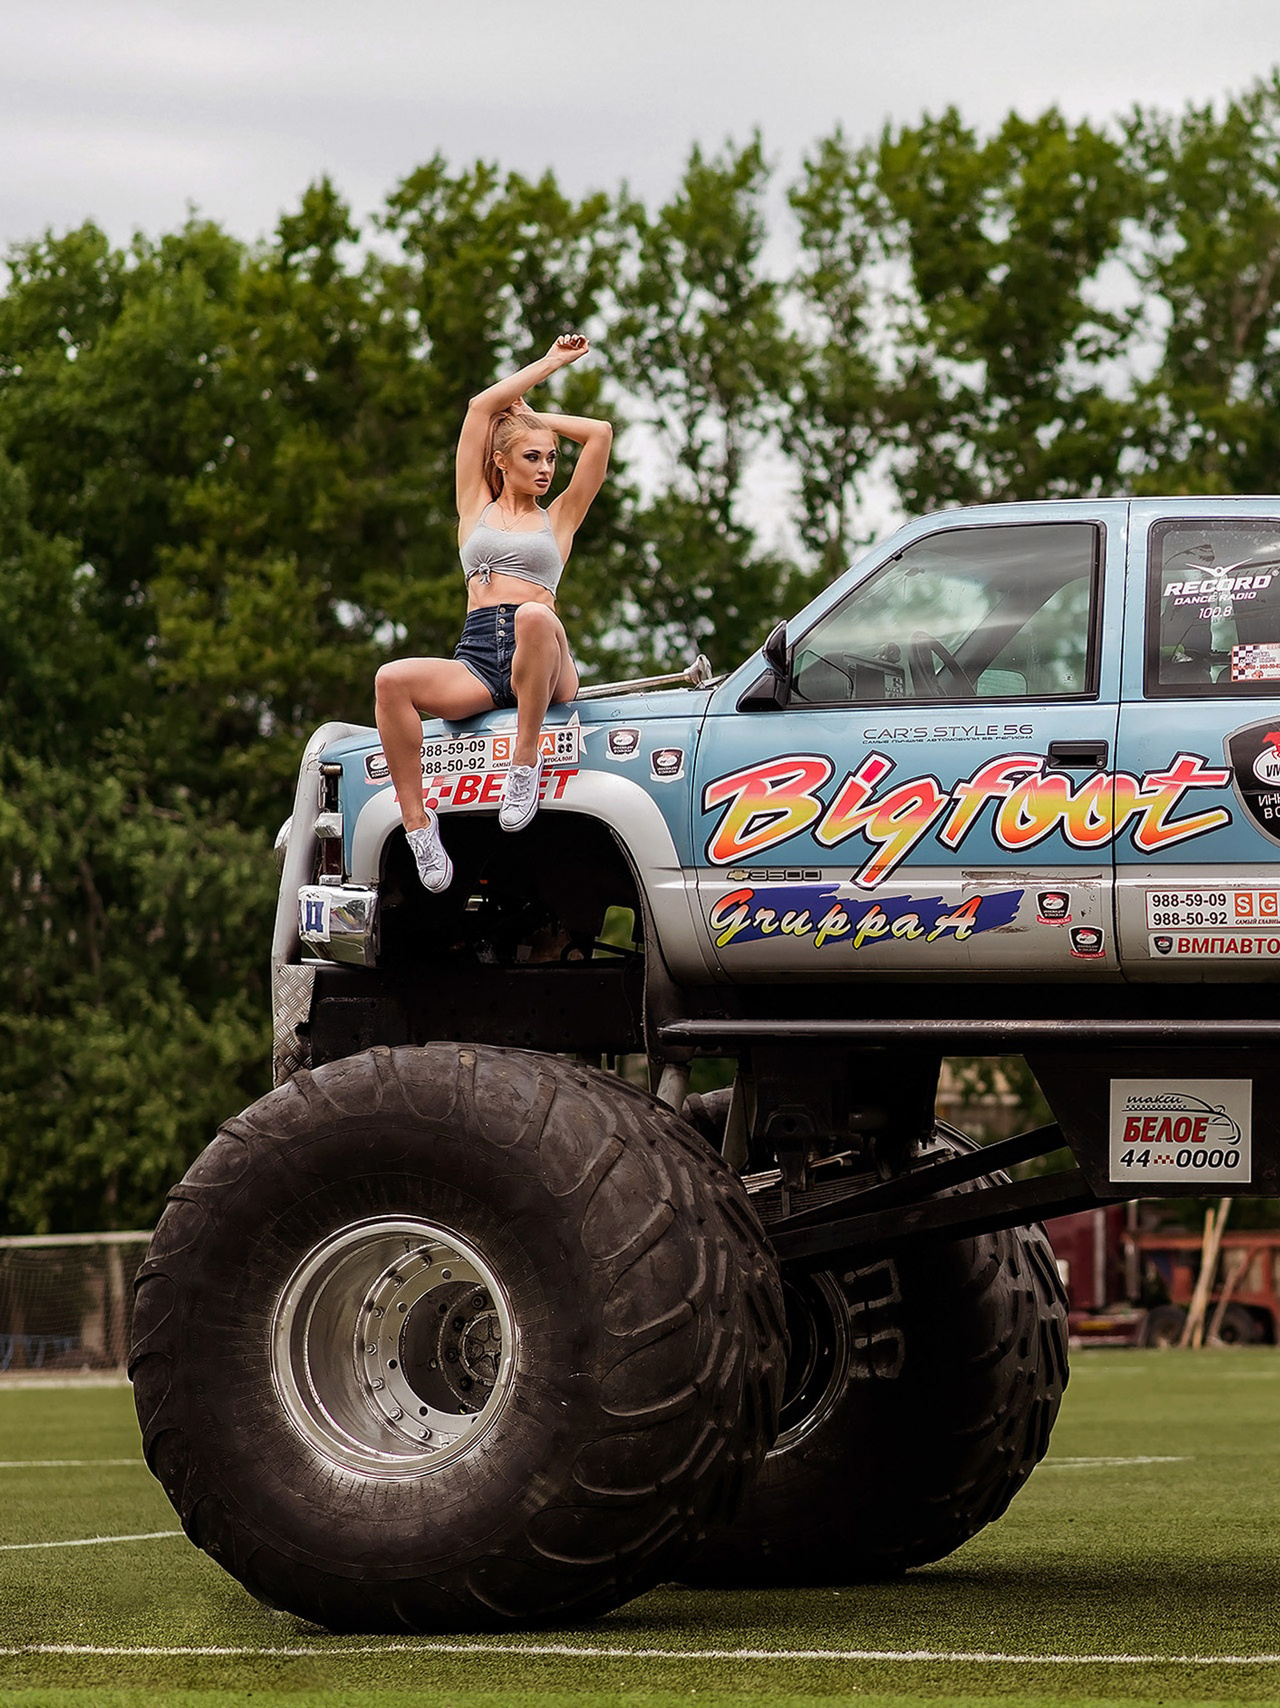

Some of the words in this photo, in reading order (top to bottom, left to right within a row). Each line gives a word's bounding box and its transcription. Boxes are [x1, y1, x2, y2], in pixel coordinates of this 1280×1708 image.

[1164, 575, 1272, 597] RECORD
[1174, 594, 1218, 605] DANCE
[1219, 592, 1257, 602] RADIO
[1199, 606, 1232, 619] 100.8
[863, 726, 928, 740] CAR'S
[933, 725, 998, 738] STYLE
[1003, 724, 1033, 736] 56
[494, 736, 555, 758] SA
[703, 751, 1233, 888] Bigfoot
[1264, 808, 1273, 819] В
[1152, 893, 1227, 908] 988-59-09
[1152, 912, 1228, 926] 988-50-92
[1177, 937, 1280, 954] ВМПАВТО
[1127, 1094, 1183, 1104] такси
[1123, 1116, 1210, 1143] БЕЛОЕ
[1119, 1149, 1151, 1168] 44
[1175, 1149, 1240, 1168] 0000
